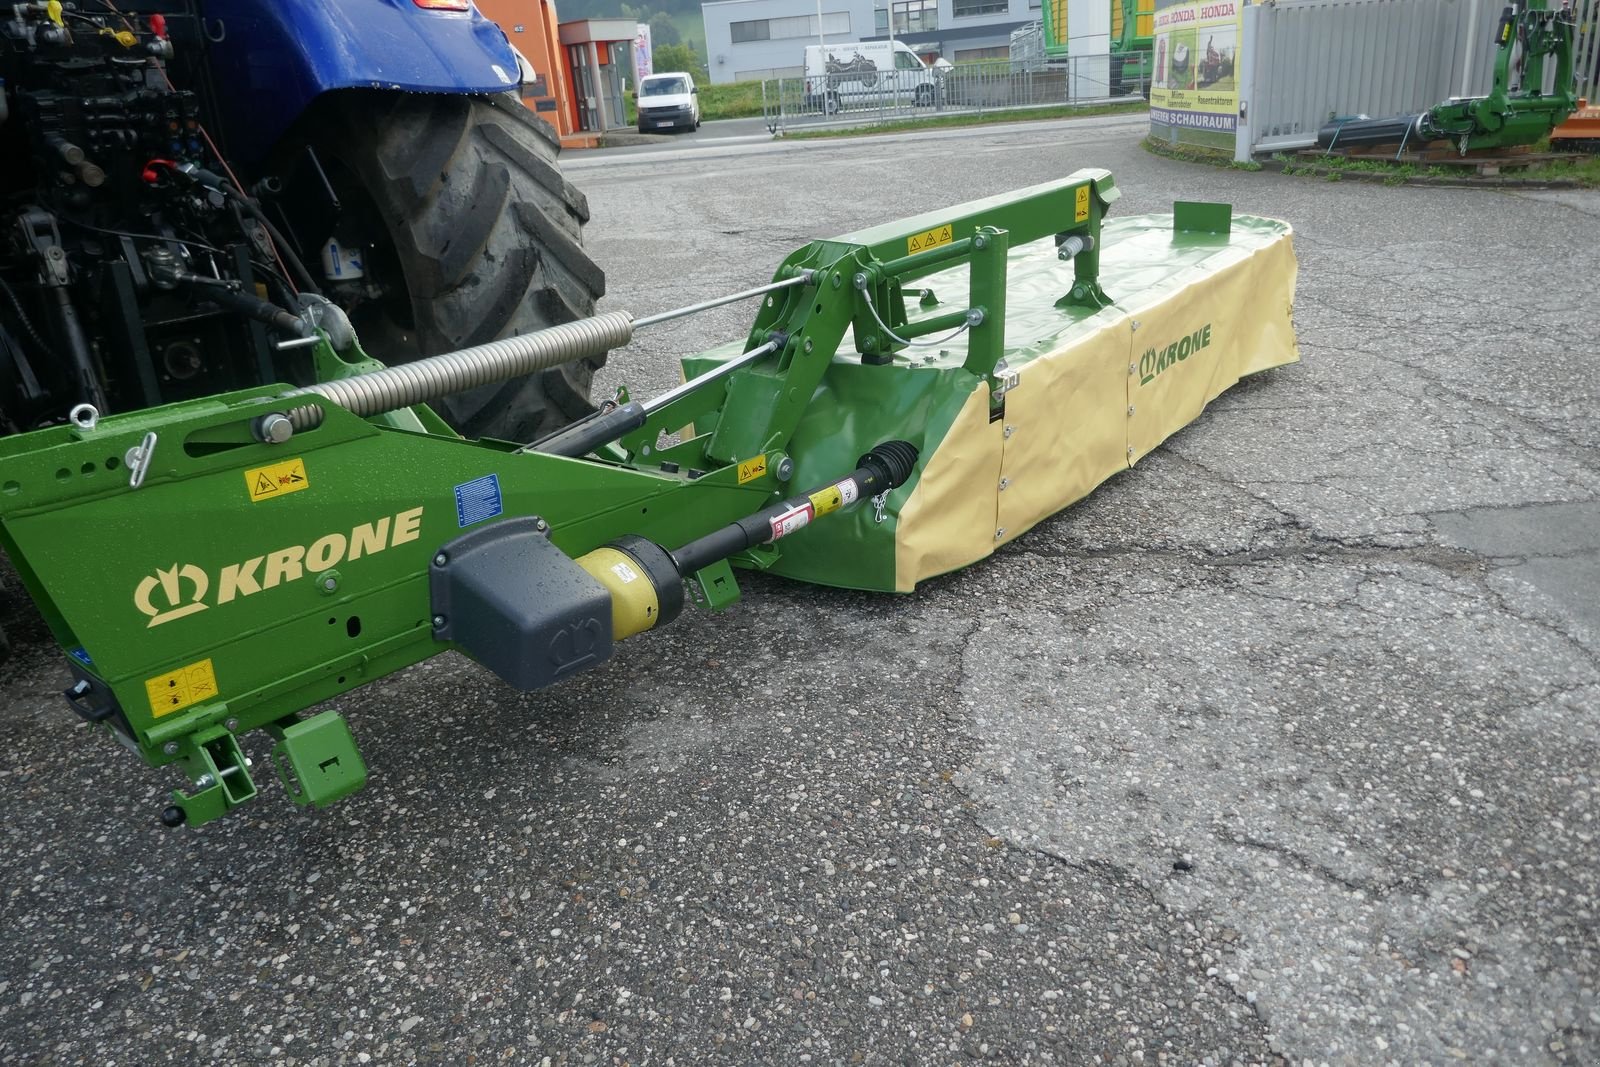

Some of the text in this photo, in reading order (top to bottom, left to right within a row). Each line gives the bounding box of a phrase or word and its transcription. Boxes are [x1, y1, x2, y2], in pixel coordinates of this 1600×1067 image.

[1200, 3, 1234, 20] HONDA
[1197, 96, 1233, 106] Rasentraktoren
[1170, 113, 1234, 129] SCHAURAUM!
[1156, 323, 1211, 375] KRONE
[217, 506, 424, 605] KRONE
